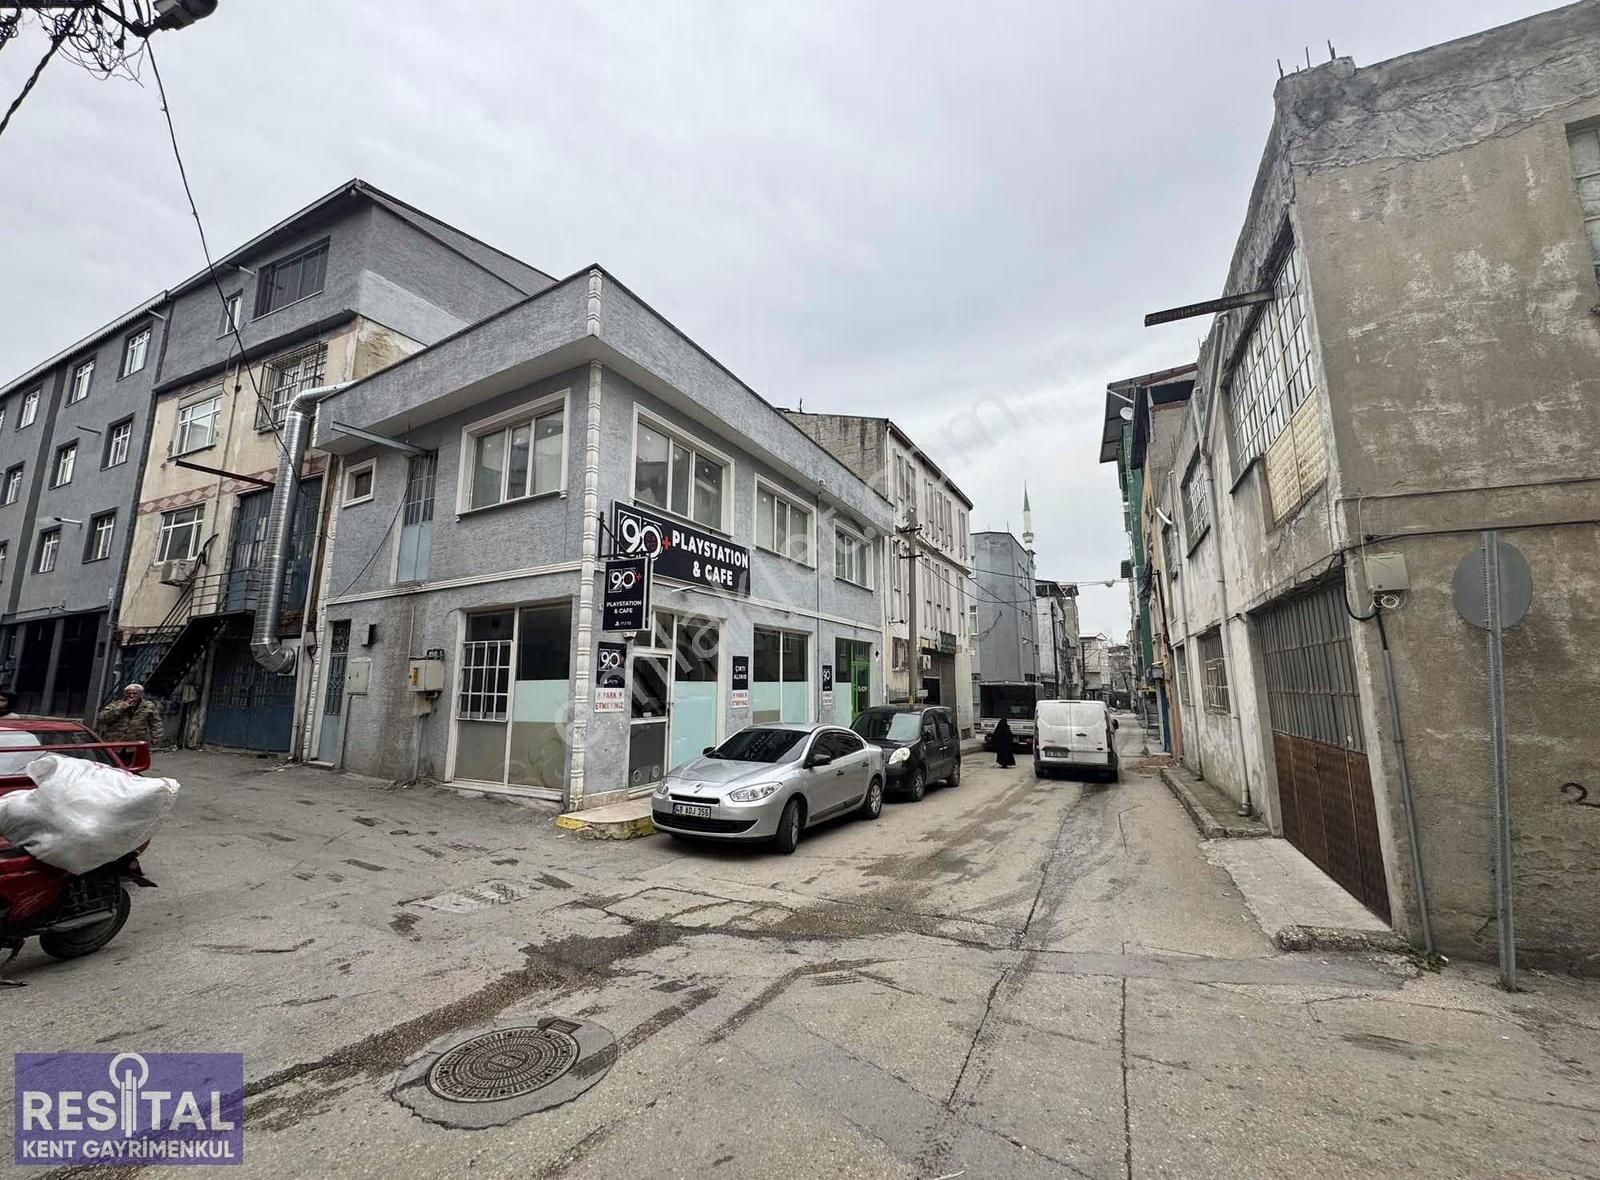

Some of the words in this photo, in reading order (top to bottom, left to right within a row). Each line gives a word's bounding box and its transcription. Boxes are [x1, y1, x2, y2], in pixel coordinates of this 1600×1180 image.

[672, 530, 749, 569] PLAYSTATION
[692, 560, 701, 578] &
[704, 563, 733, 586] CAFE
[602, 691, 617, 699] PARK
